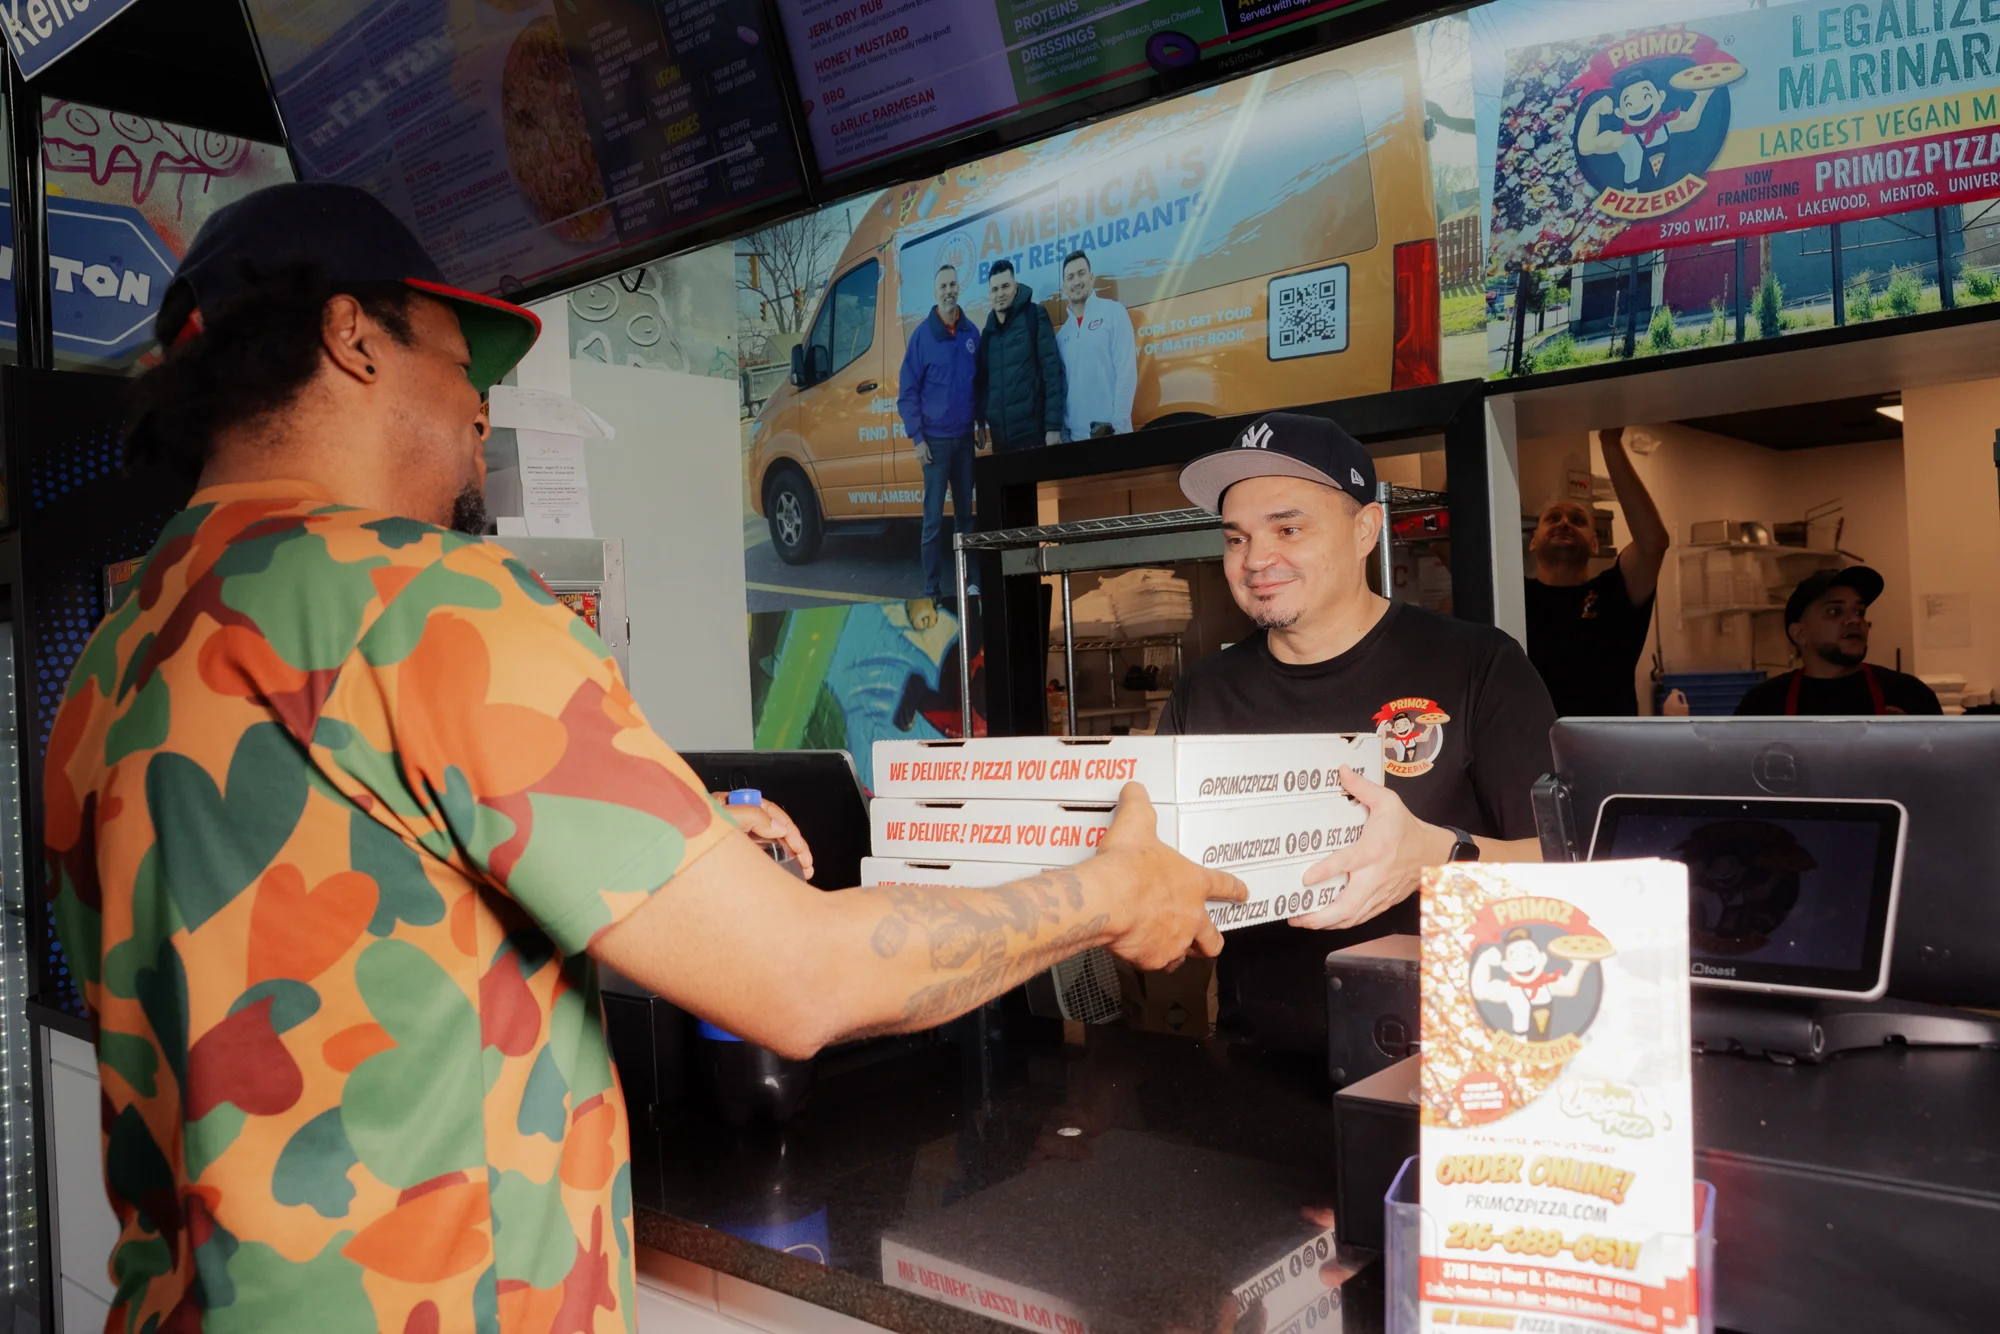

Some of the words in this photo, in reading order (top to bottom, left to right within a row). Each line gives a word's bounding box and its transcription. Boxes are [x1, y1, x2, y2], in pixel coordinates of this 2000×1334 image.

[668, 15, 680, 28] BEEF
[808, 22, 832, 40] JERK
[835, 8, 857, 28] DRY
[861, 0, 884, 17] RUB
[1014, 0, 1079, 32] PROTEINS
[1240, 5, 1271, 23] Served
[0, 0, 90, 56] Kens
[694, 32, 710, 46] STEAK
[898, 40, 915, 54] really
[915, 33, 932, 47] really
[933, 25, 952, 40] good!
[1047, 50, 1074, 67] Creamy
[1075, 44, 1100, 58] Ranch,
[1101, 30, 1124, 48] Vegan
[1126, 24, 1152, 40] Ranch,
[1152, 15, 1170, 30] Bleu
[1171, 6, 1204, 24] Cheese,
[815, 48, 852, 74] HONEY
[854, 26, 909, 58] MUSTARD
[1021, 26, 1096, 63] DRESSINGS
[1608, 32, 1698, 68] PRIMOZ
[730, 58, 748, 74] STEAK
[1026, 68, 1057, 85] Balsamic
[1058, 55, 1097, 76] Vinaigrette
[1218, 48, 1264, 70] INSIGNIA
[654, 64, 681, 88] VEGAN
[734, 70, 756, 88] CHICKEN
[1779, 32, 2000, 111] MARINAR
[668, 83, 692, 100] SAUSAGE
[822, 87, 845, 105] BBQ
[831, 112, 871, 136] GARLIC
[872, 88, 935, 120] PARMESAN
[920, 104, 937, 117] garlic
[394, 127, 428, 150] UNIVERSITY
[429, 115, 451, 132] CIRCLE
[664, 112, 700, 144] VEGGIES
[730, 118, 751, 133] PEPPER
[750, 122, 778, 141] TOMATOES
[1760, 117, 1864, 157] LARGEST
[1876, 100, 1960, 137] VEGAN
[672, 143, 690, 158] PEPPER
[417, 161, 442, 179] COOPER
[1745, 170, 1772, 186] NOW
[414, 202, 436, 220] BACON
[461, 170, 510, 199] CHEESEBURGER
[732, 176, 755, 190] SPINACH
[1716, 182, 1800, 206] FRANCHISING
[673, 196, 698, 212] PINEAPPLE
[979, 144, 1207, 259] AMERICA'S
[1602, 179, 1701, 214] PIZZERIA
[1660, 222, 1690, 238] 3790
[1798, 194, 1870, 218] LAKEWOOD,
[1880, 184, 1939, 204] MENTOR,
[1949, 172, 2000, 192] UNIVER
[424, 236, 452, 252] MADISON
[979, 253, 1024, 284] BT
[1030, 192, 1209, 270] RESTAURANTS
[1138, 323, 1167, 338] CODE
[1171, 321, 1186, 332] TO
[1189, 316, 1213, 328] GET
[1216, 306, 1252, 322] YOUR
[1144, 344, 1160, 355] OF
[1208, 328, 1244, 344] BOOK
[858, 426, 888, 442] FIND
[1241, 422, 1273, 448] NY
[1390, 698, 1429, 711] PRIMOZ
[890, 762, 908, 781] WE
[911, 761, 968, 781] DELIVER!
[971, 761, 1012, 781] PIZZA
[1017, 759, 1046, 780] YOU
[1050, 759, 1080, 780] CAN
[1085, 758, 1137, 780] CRUST
[1387, 762, 1430, 774] PIZZERIA
[1199, 773, 1279, 797] @PRIMOZPIZZA
[886, 822, 906, 841] WE
[908, 823, 967, 843] DELIVER!
[970, 824, 1011, 844] PIZZA
[1016, 825, 1046, 846] YOU
[1050, 826, 1082, 846] CAN
[1203, 837, 1280, 864] @PRIMOZPIZZA
[1326, 828, 1342, 846] EST.
[1318, 888, 1335, 905] EST.
[1493, 898, 1574, 924] PRIMOZ
[1704, 965, 1736, 977] toast
[1496, 1034, 1583, 1059] PIZZERIA
[1467, 1134, 1527, 1146] FRANHISE
[1564, 1142, 1577, 1150] US
[1436, 1153, 1524, 1186] ORDER
[1528, 1154, 1636, 1206] ONLINE!
[1466, 1195, 1608, 1223] PRIMOZPIZZA.COM
[1444, 1221, 1643, 1270] 216-688-0511
